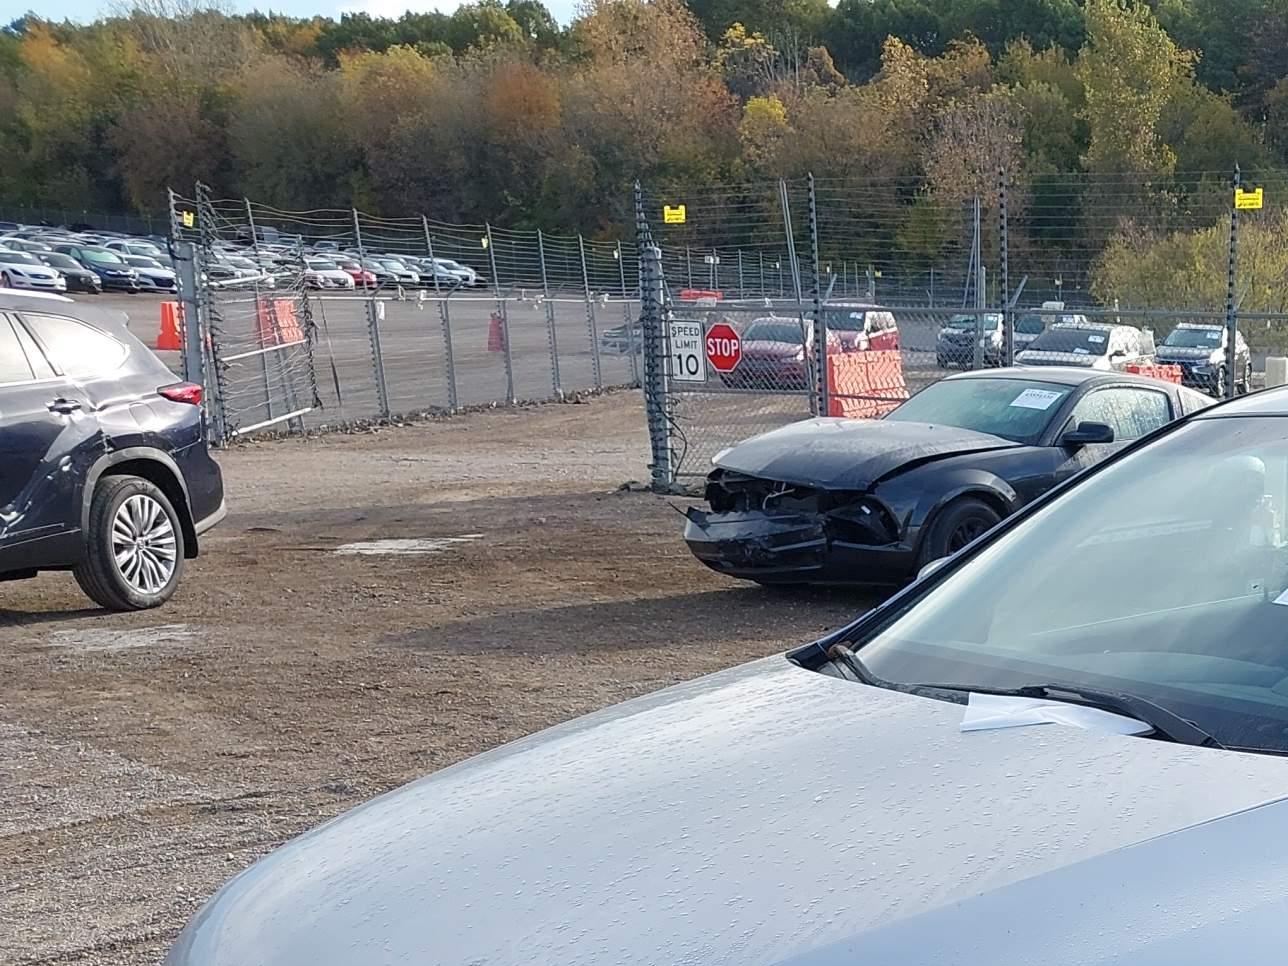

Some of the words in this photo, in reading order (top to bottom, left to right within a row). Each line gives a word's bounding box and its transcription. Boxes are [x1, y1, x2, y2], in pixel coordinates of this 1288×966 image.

[671, 326, 700, 337] SPEED
[675, 340, 698, 349] LIMIT
[707, 338, 739, 357] STOP
[676, 353, 699, 375] 10
